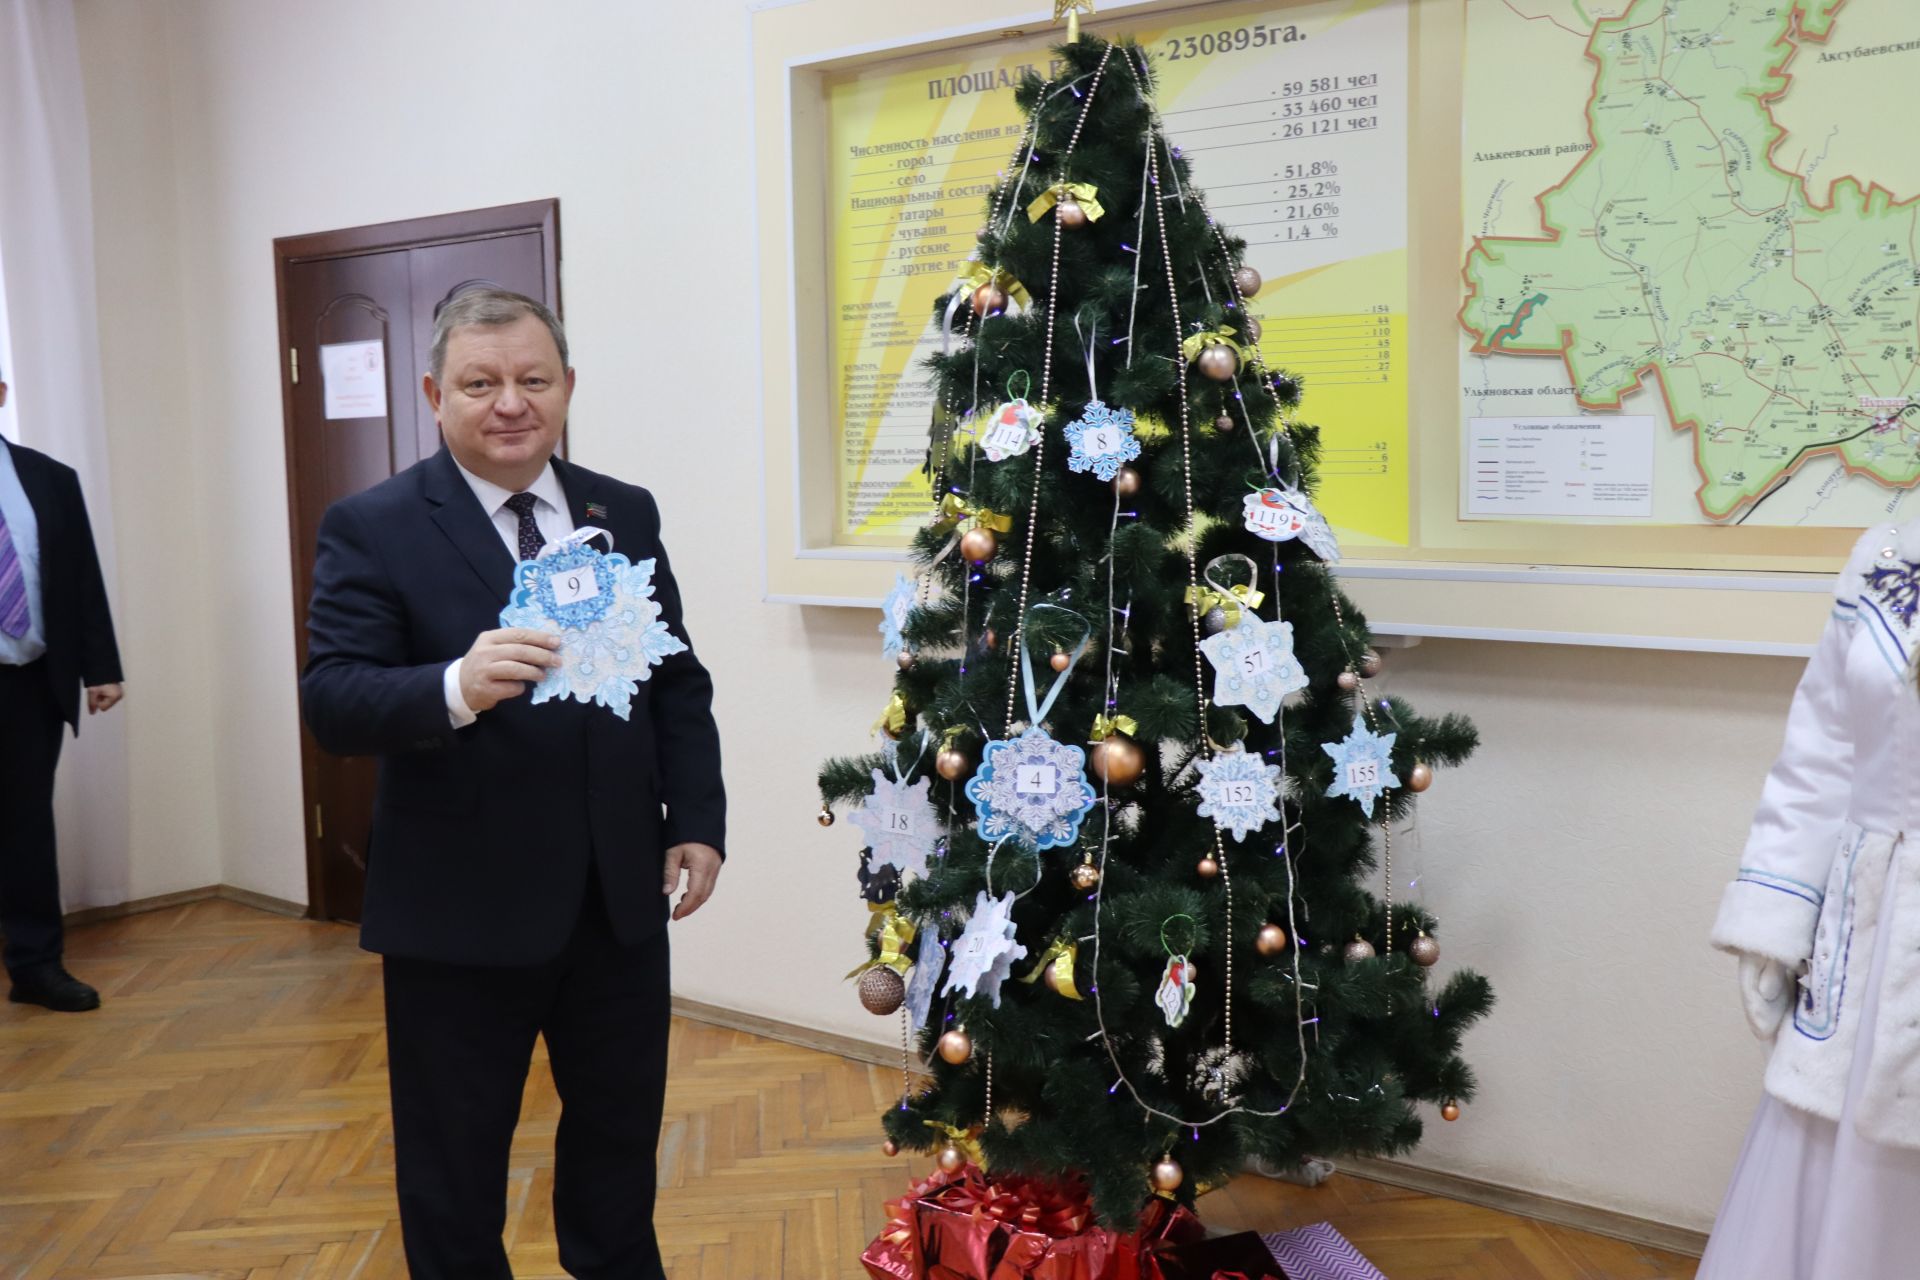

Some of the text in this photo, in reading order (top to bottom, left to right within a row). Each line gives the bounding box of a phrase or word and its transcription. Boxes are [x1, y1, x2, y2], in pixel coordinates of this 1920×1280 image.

[1282, 73, 1378, 97] 59 581 чел
[1282, 94, 1378, 117] 33 460 чел
[1282, 115, 1378, 138] 26 121 чел
[850, 124, 1021, 157] Численность населения на
[1472, 142, 1593, 162] Алькеевский район
[896, 155, 934, 170] город
[1284, 160, 1338, 179] 51,8%
[897, 173, 926, 186] село
[851, 183, 993, 210] Национальный состав
[1287, 181, 1341, 199] 25,2%
[898, 207, 945, 223] татары
[1286, 202, 1340, 219] 21,6%
[898, 224, 947, 241] чуваши
[1287, 224, 1311, 240] 1,4
[899, 242, 950, 259] русские
[901, 260, 943, 276] другие
[1372, 304, 1389, 313] 154
[1372, 328, 1391, 336] 110
[1463, 385, 1578, 397] Ульяновская област
[995, 428, 1022, 447] 114
[1096, 433, 1107, 450] 8
[1258, 510, 1289, 526] 119
[567, 576, 581, 596] 9
[1244, 650, 1263, 673] 57
[1030, 771, 1042, 788] 4
[1351, 765, 1375, 784] 155
[1225, 786, 1253, 803] 152
[889, 812, 909, 831] 18
